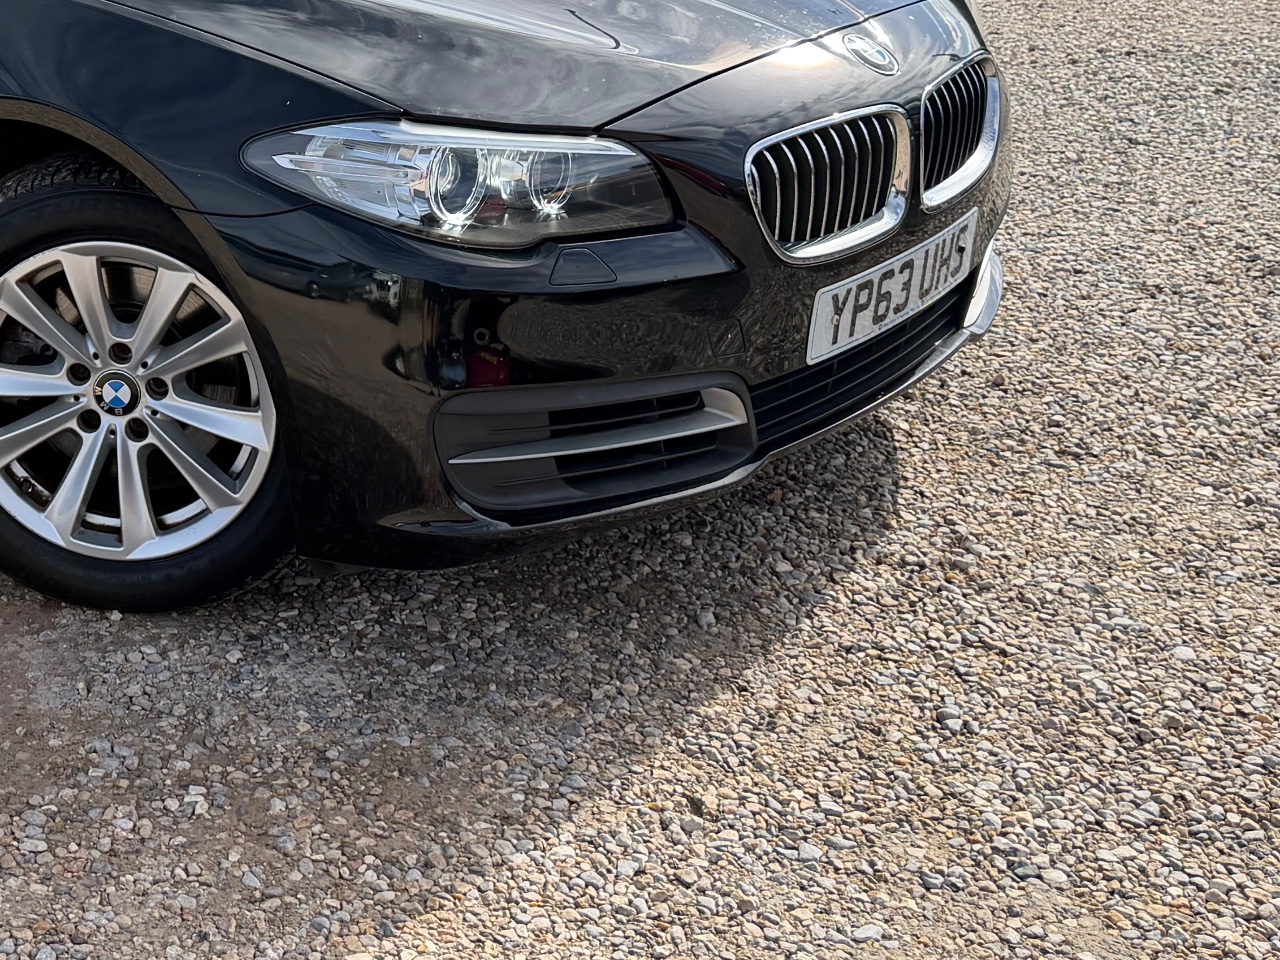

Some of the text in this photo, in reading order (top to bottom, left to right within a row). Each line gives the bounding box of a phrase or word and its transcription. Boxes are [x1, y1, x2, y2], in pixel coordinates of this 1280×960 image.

[831, 258, 915, 346] YP63
[918, 225, 969, 300] UHS
[94, 386, 123, 416] BMW
